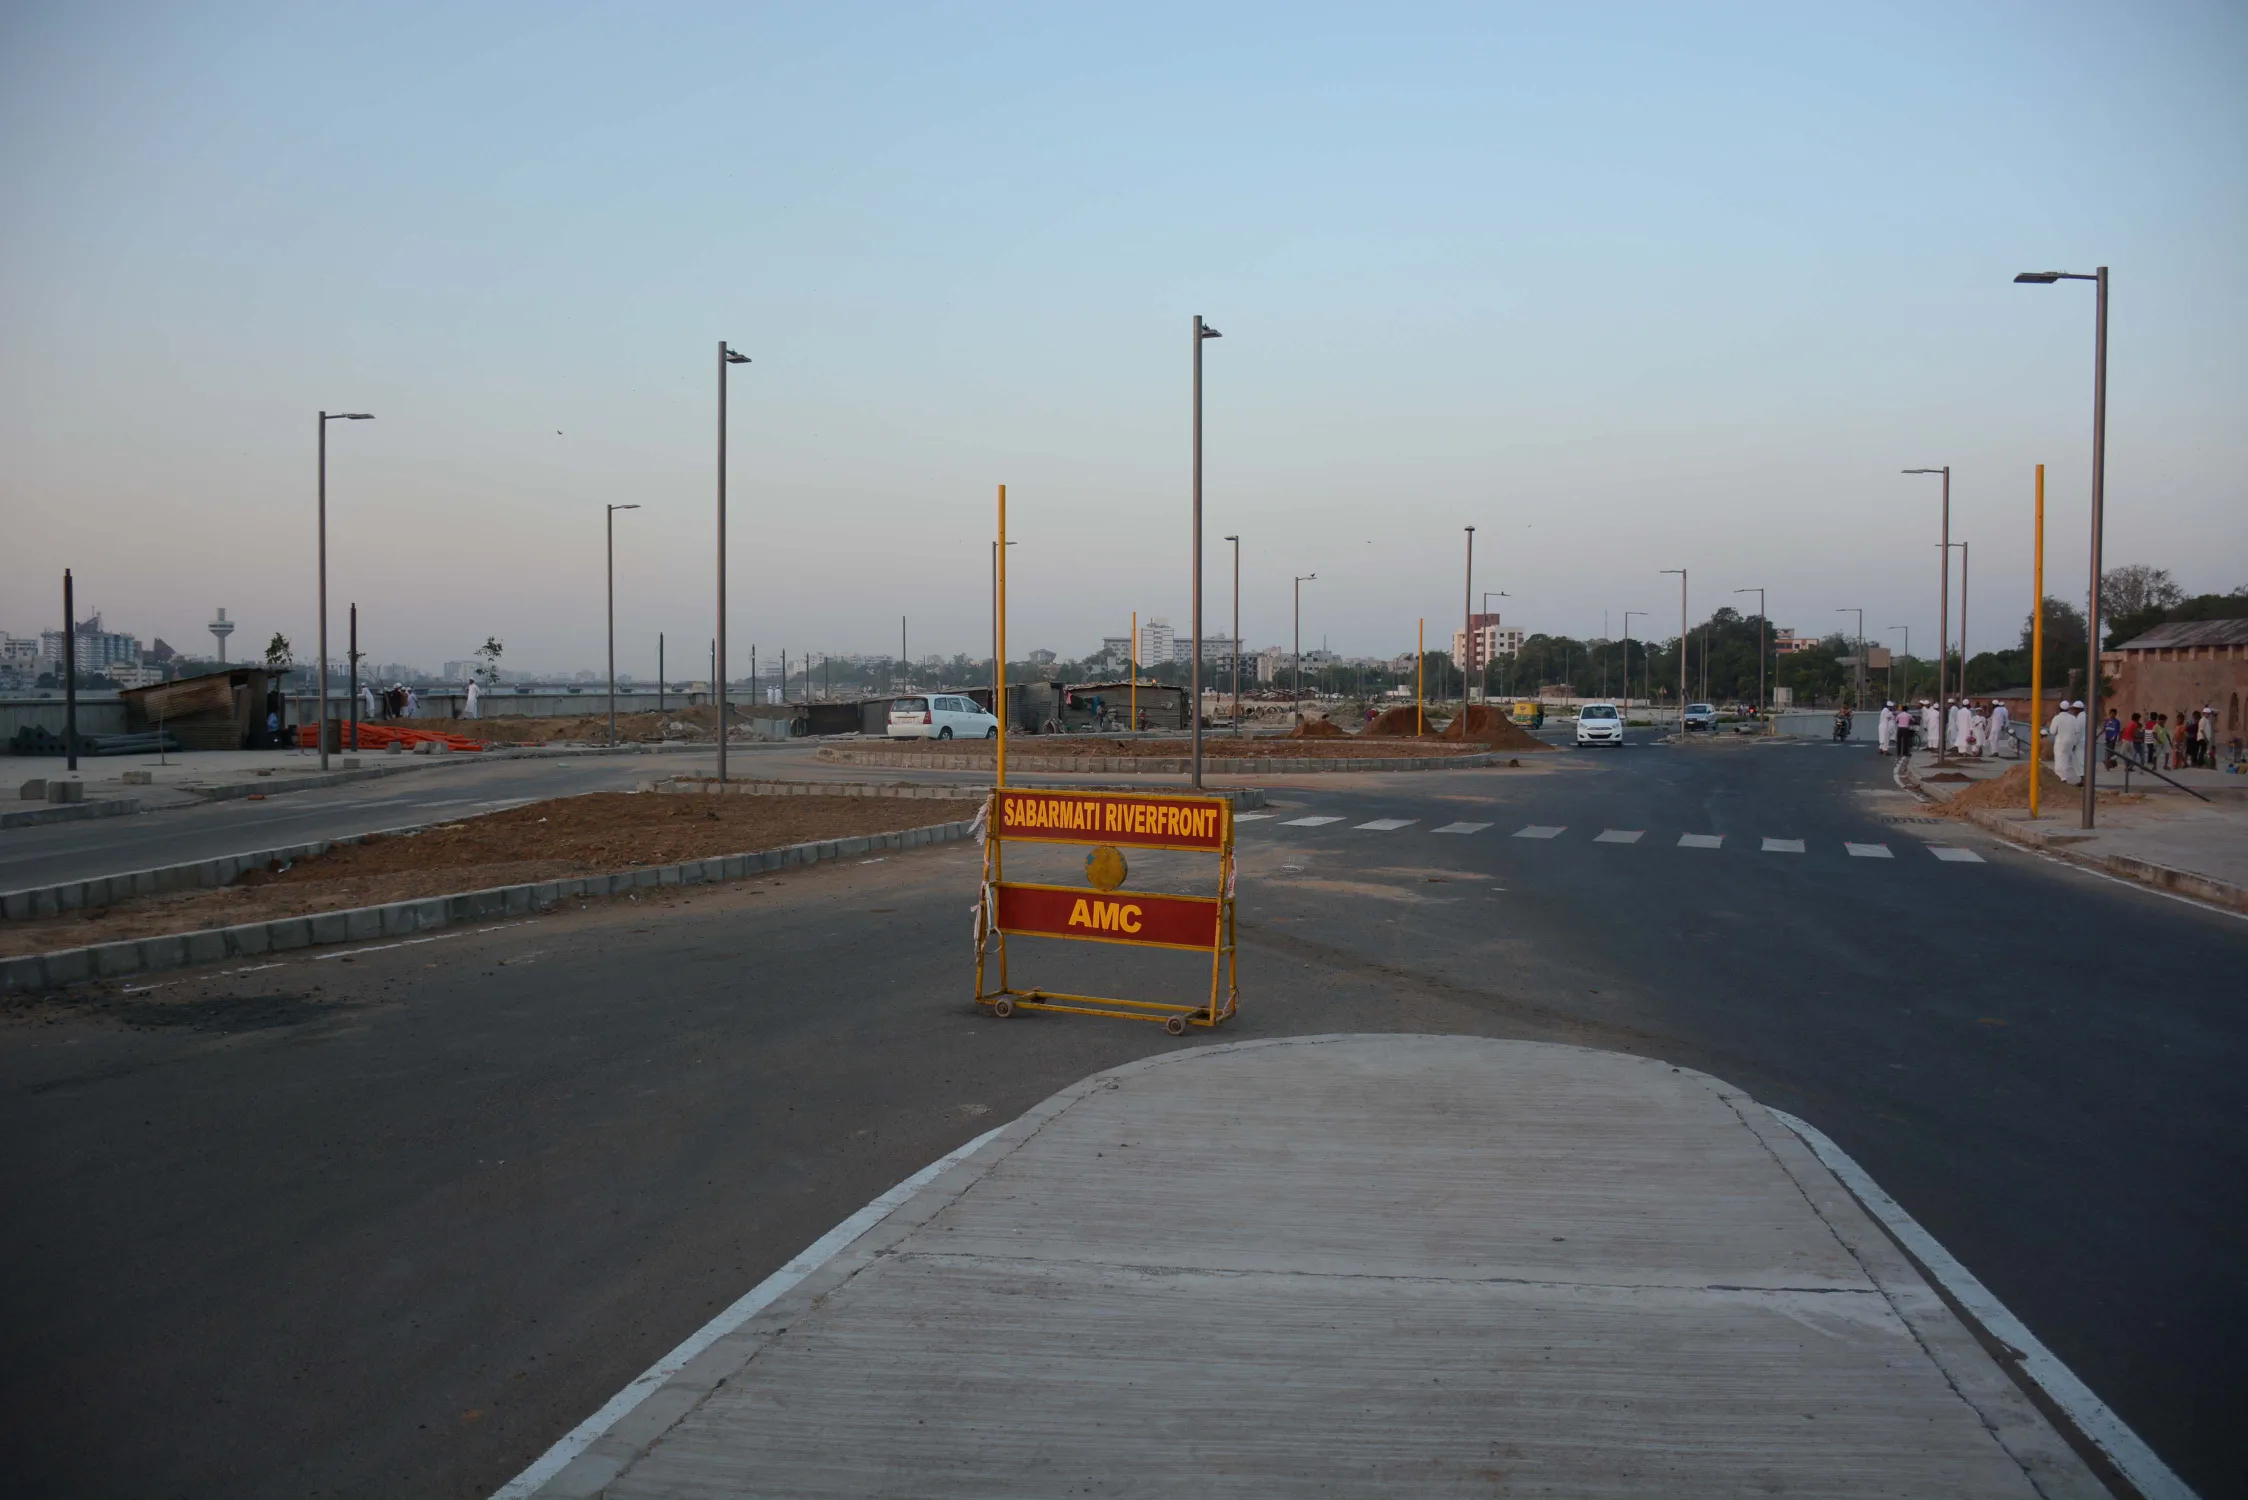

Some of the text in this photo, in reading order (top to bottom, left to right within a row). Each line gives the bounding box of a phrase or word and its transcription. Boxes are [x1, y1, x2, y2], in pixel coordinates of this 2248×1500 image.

[1004, 798, 1217, 837] SABARMATI RIVERFRONT
[1068, 899, 1142, 933] AMC
